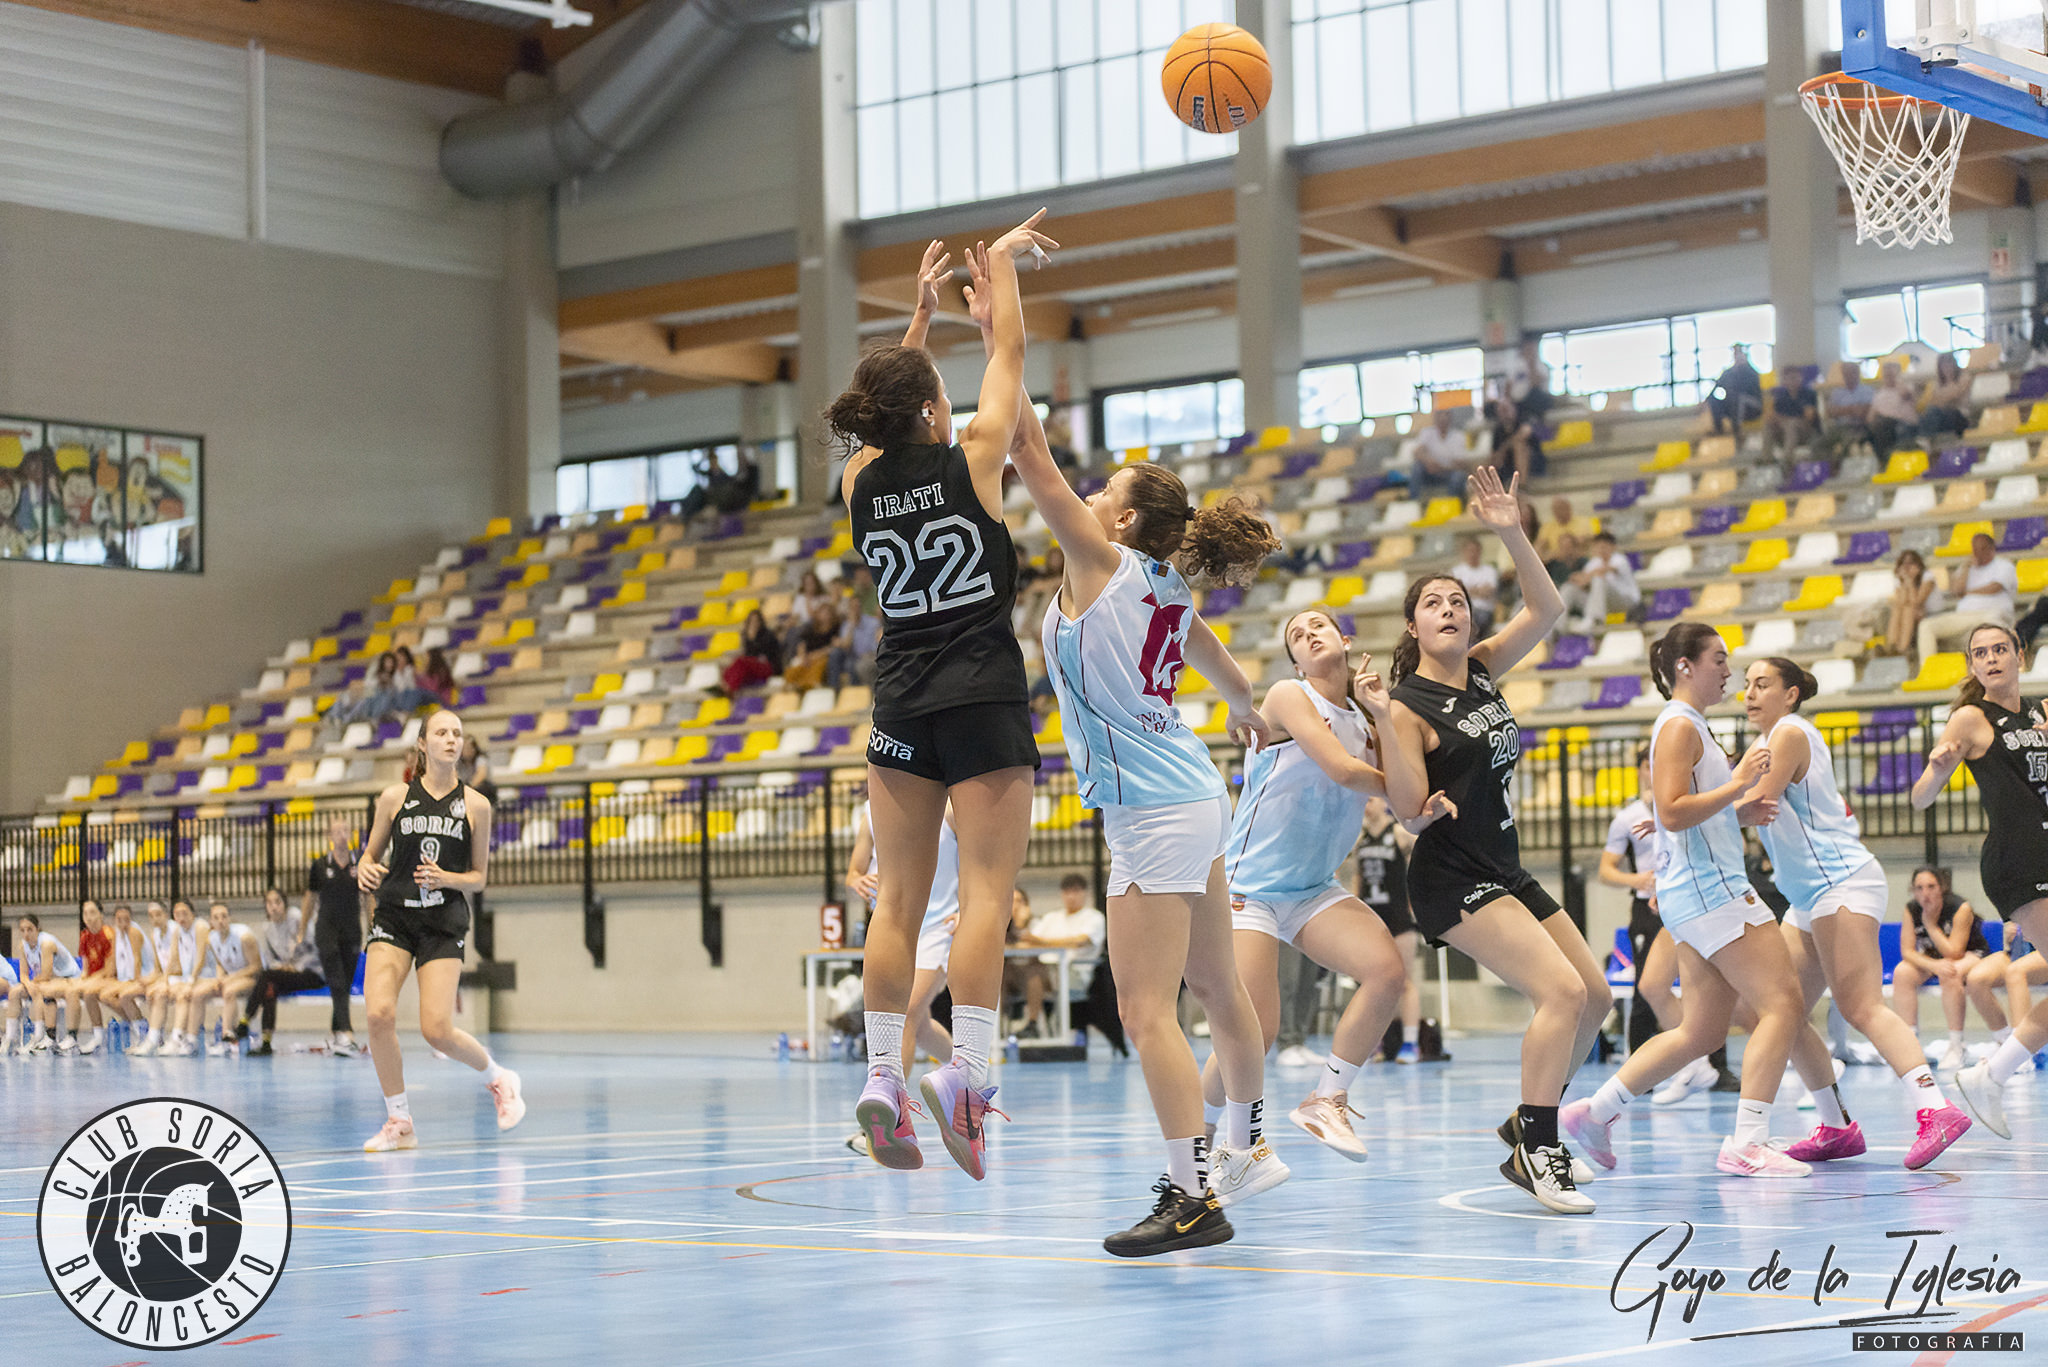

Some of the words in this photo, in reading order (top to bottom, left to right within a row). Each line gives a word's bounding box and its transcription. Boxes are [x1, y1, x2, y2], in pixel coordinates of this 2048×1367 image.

[872, 482, 945, 520] IRATI
[861, 514, 996, 618] 22
[868, 726, 913, 761] Soria
[1488, 721, 1520, 769] 20
[2025, 751, 2048, 782] 15
[400, 815, 464, 841] SORIA
[420, 836, 441, 865] 9
[823, 907, 843, 941] 5
